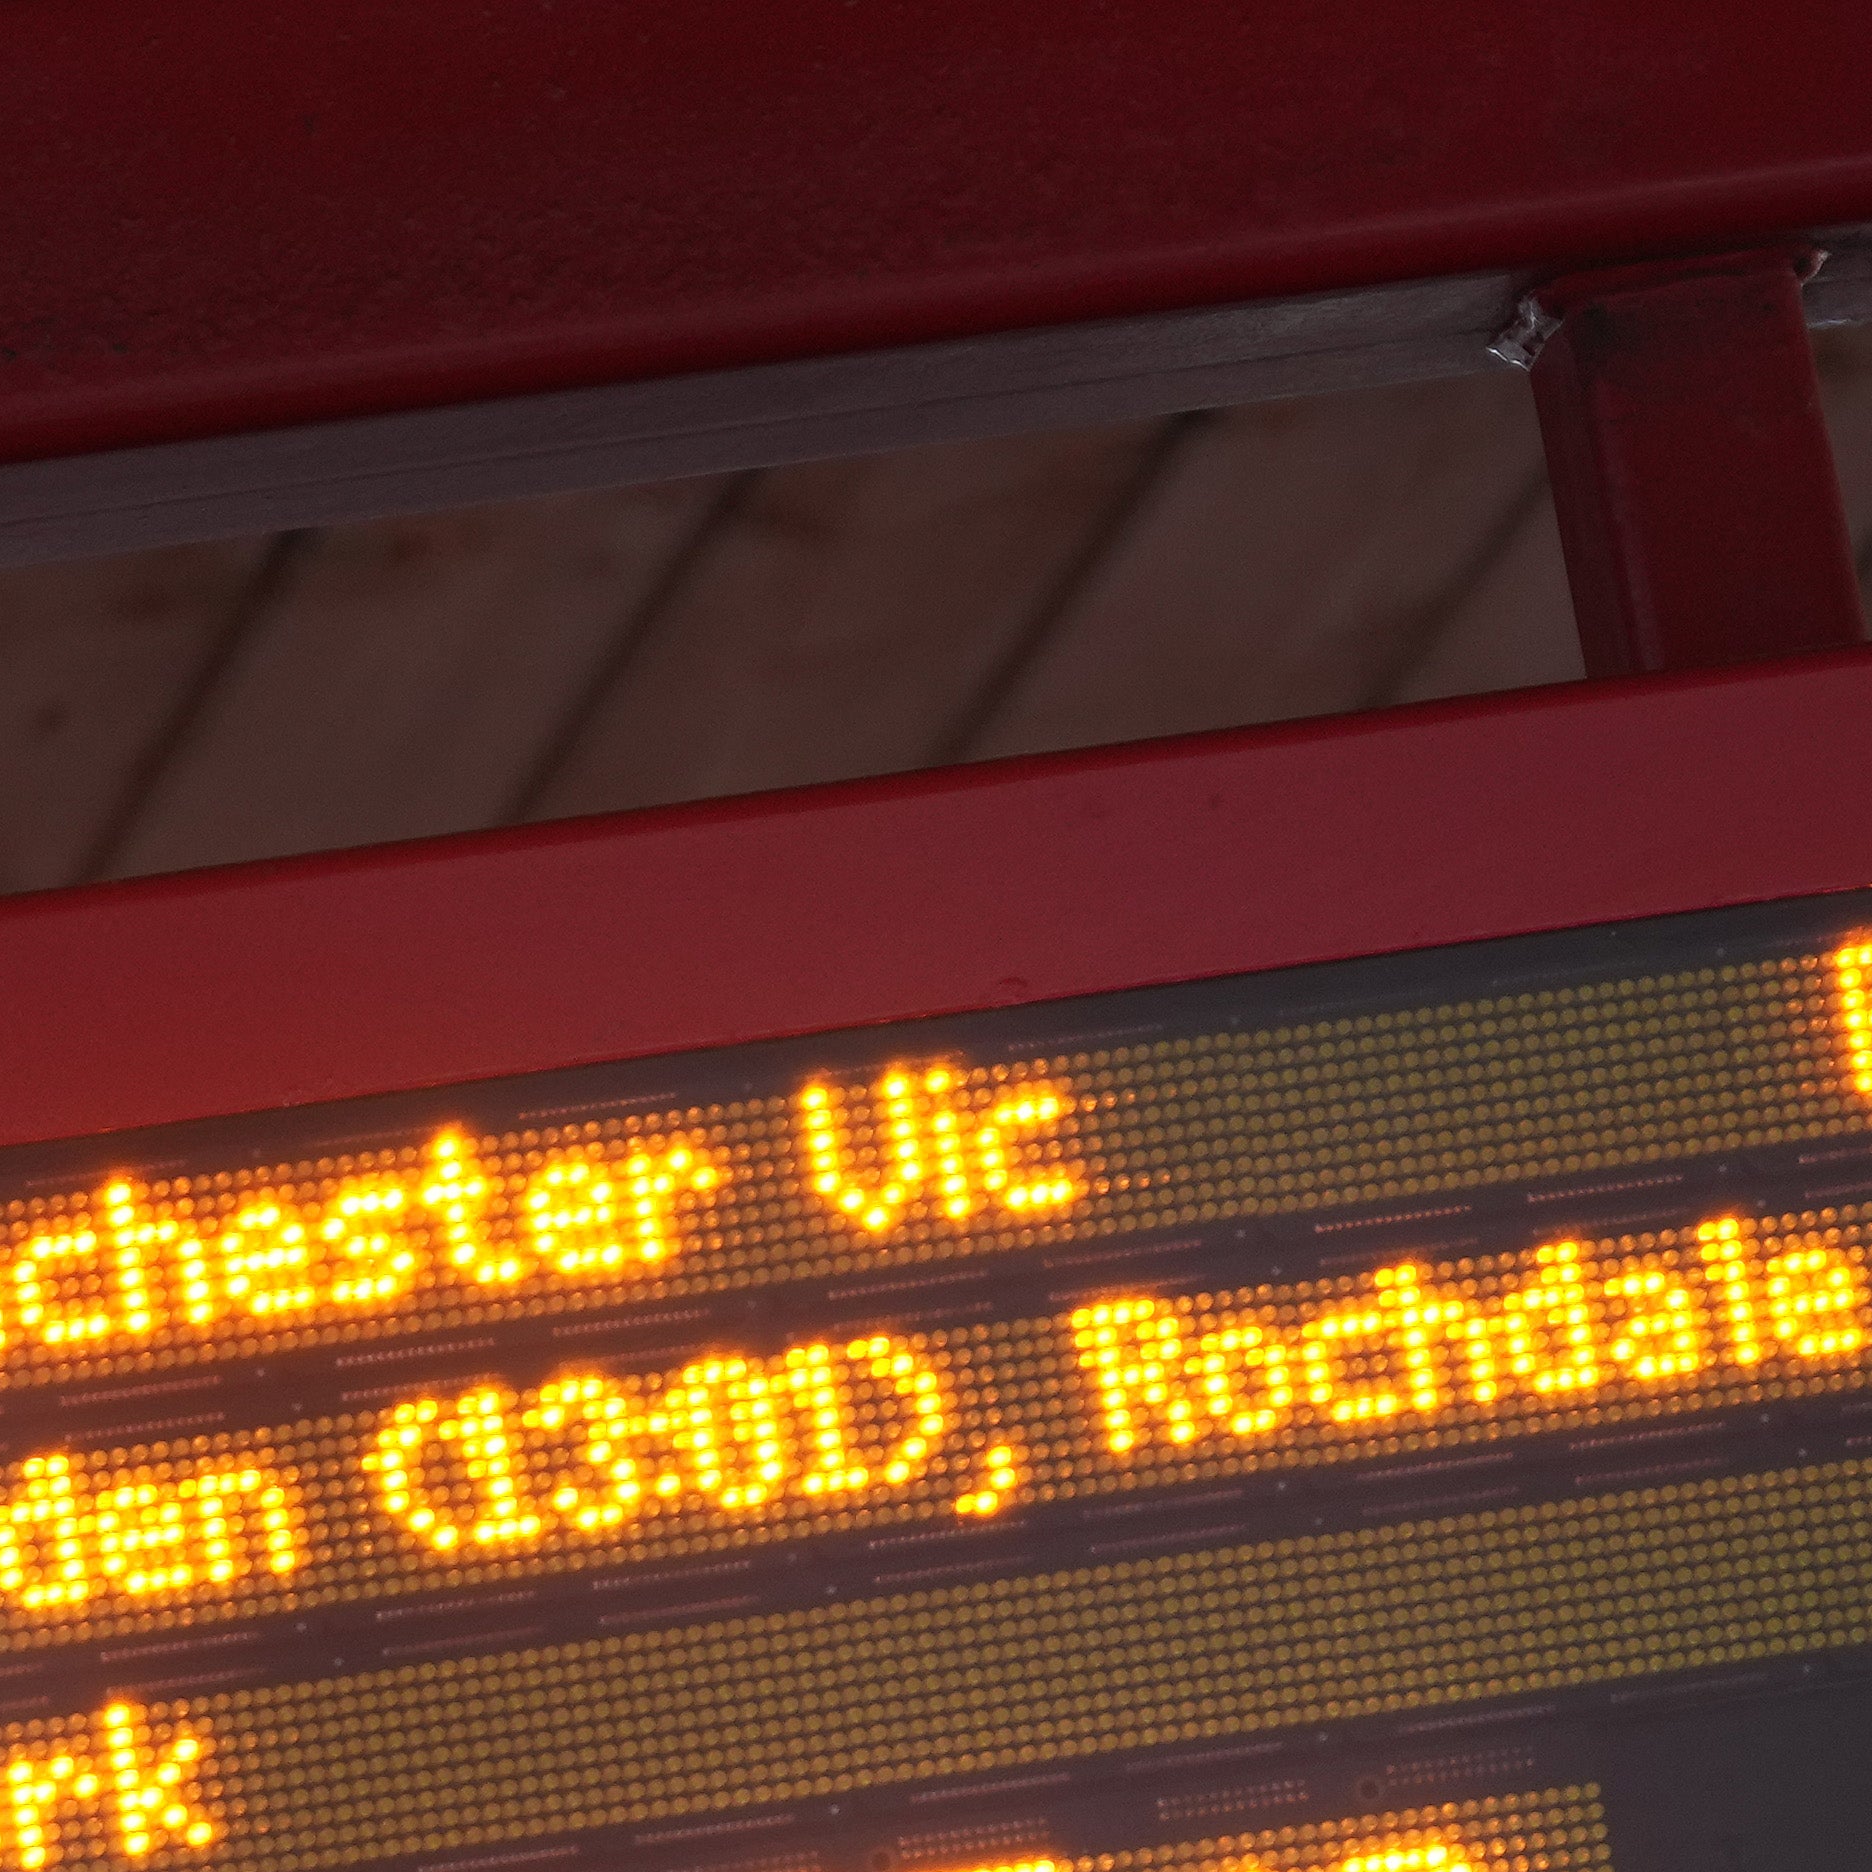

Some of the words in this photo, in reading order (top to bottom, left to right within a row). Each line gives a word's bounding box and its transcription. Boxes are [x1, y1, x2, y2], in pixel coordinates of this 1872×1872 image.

[798, 1065, 1075, 1233] Vic
[362, 1336, 1017, 1551] (13:01),
[1070, 1218, 1868, 1452] Rochdale
